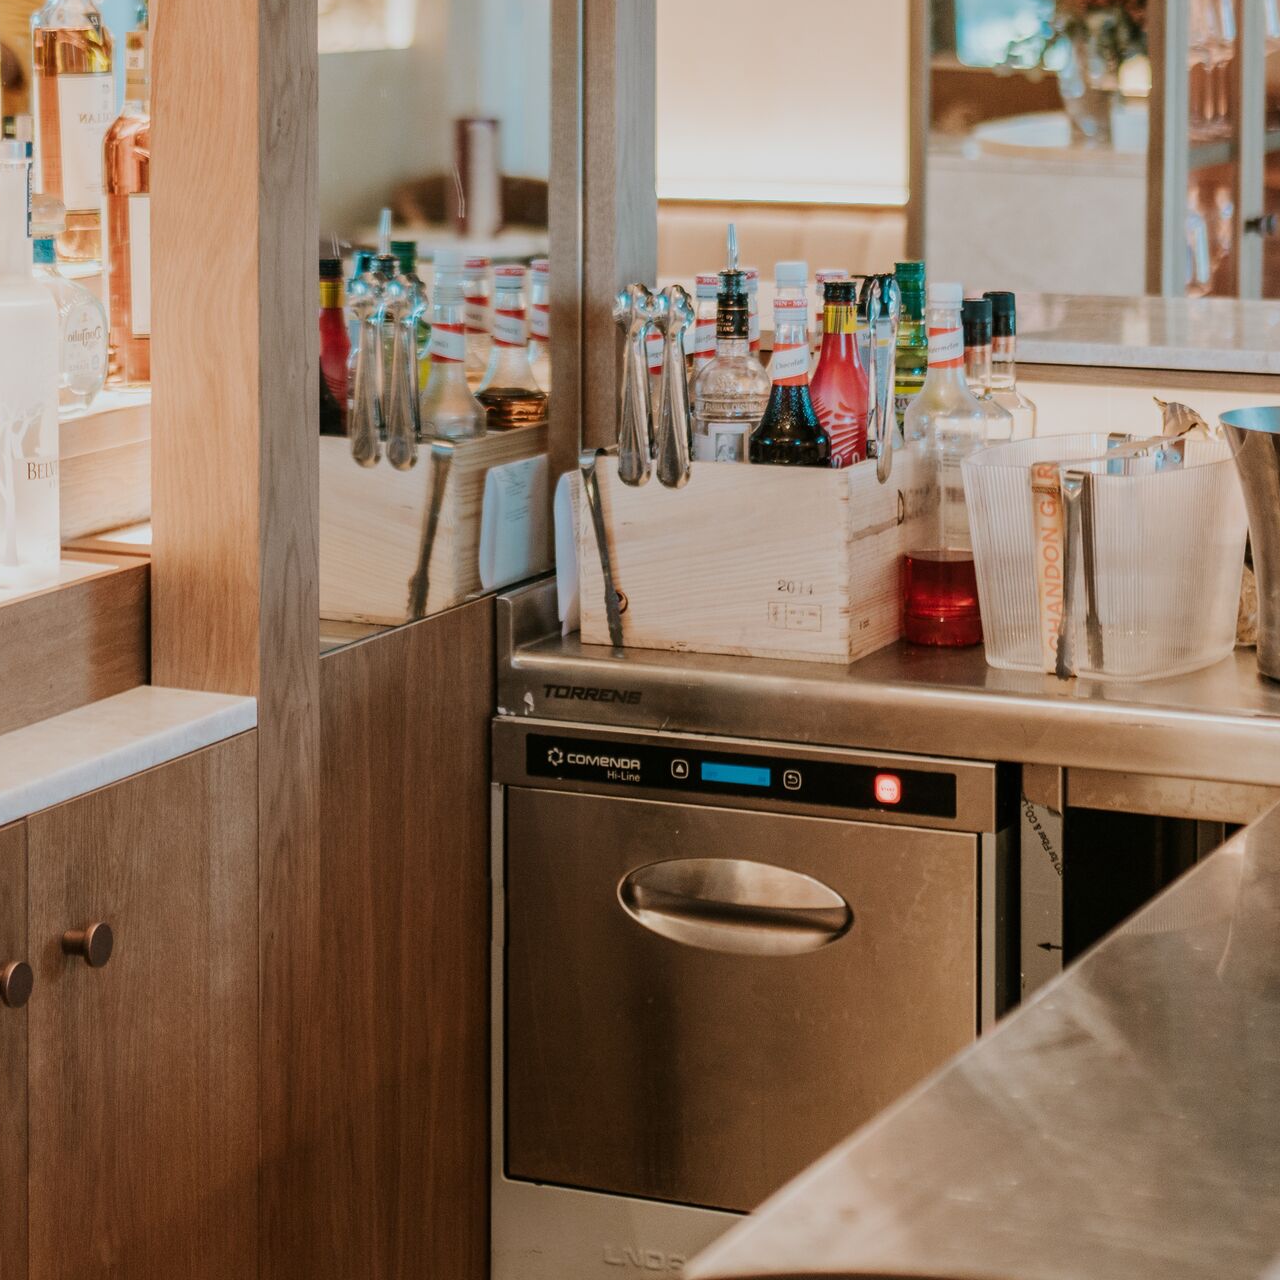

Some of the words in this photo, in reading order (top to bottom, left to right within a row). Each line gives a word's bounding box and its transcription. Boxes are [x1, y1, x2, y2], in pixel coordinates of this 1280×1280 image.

[27, 462, 57, 480] BELV
[544, 684, 642, 705] TORRENS
[607, 770, 641, 782] Hi-Line
